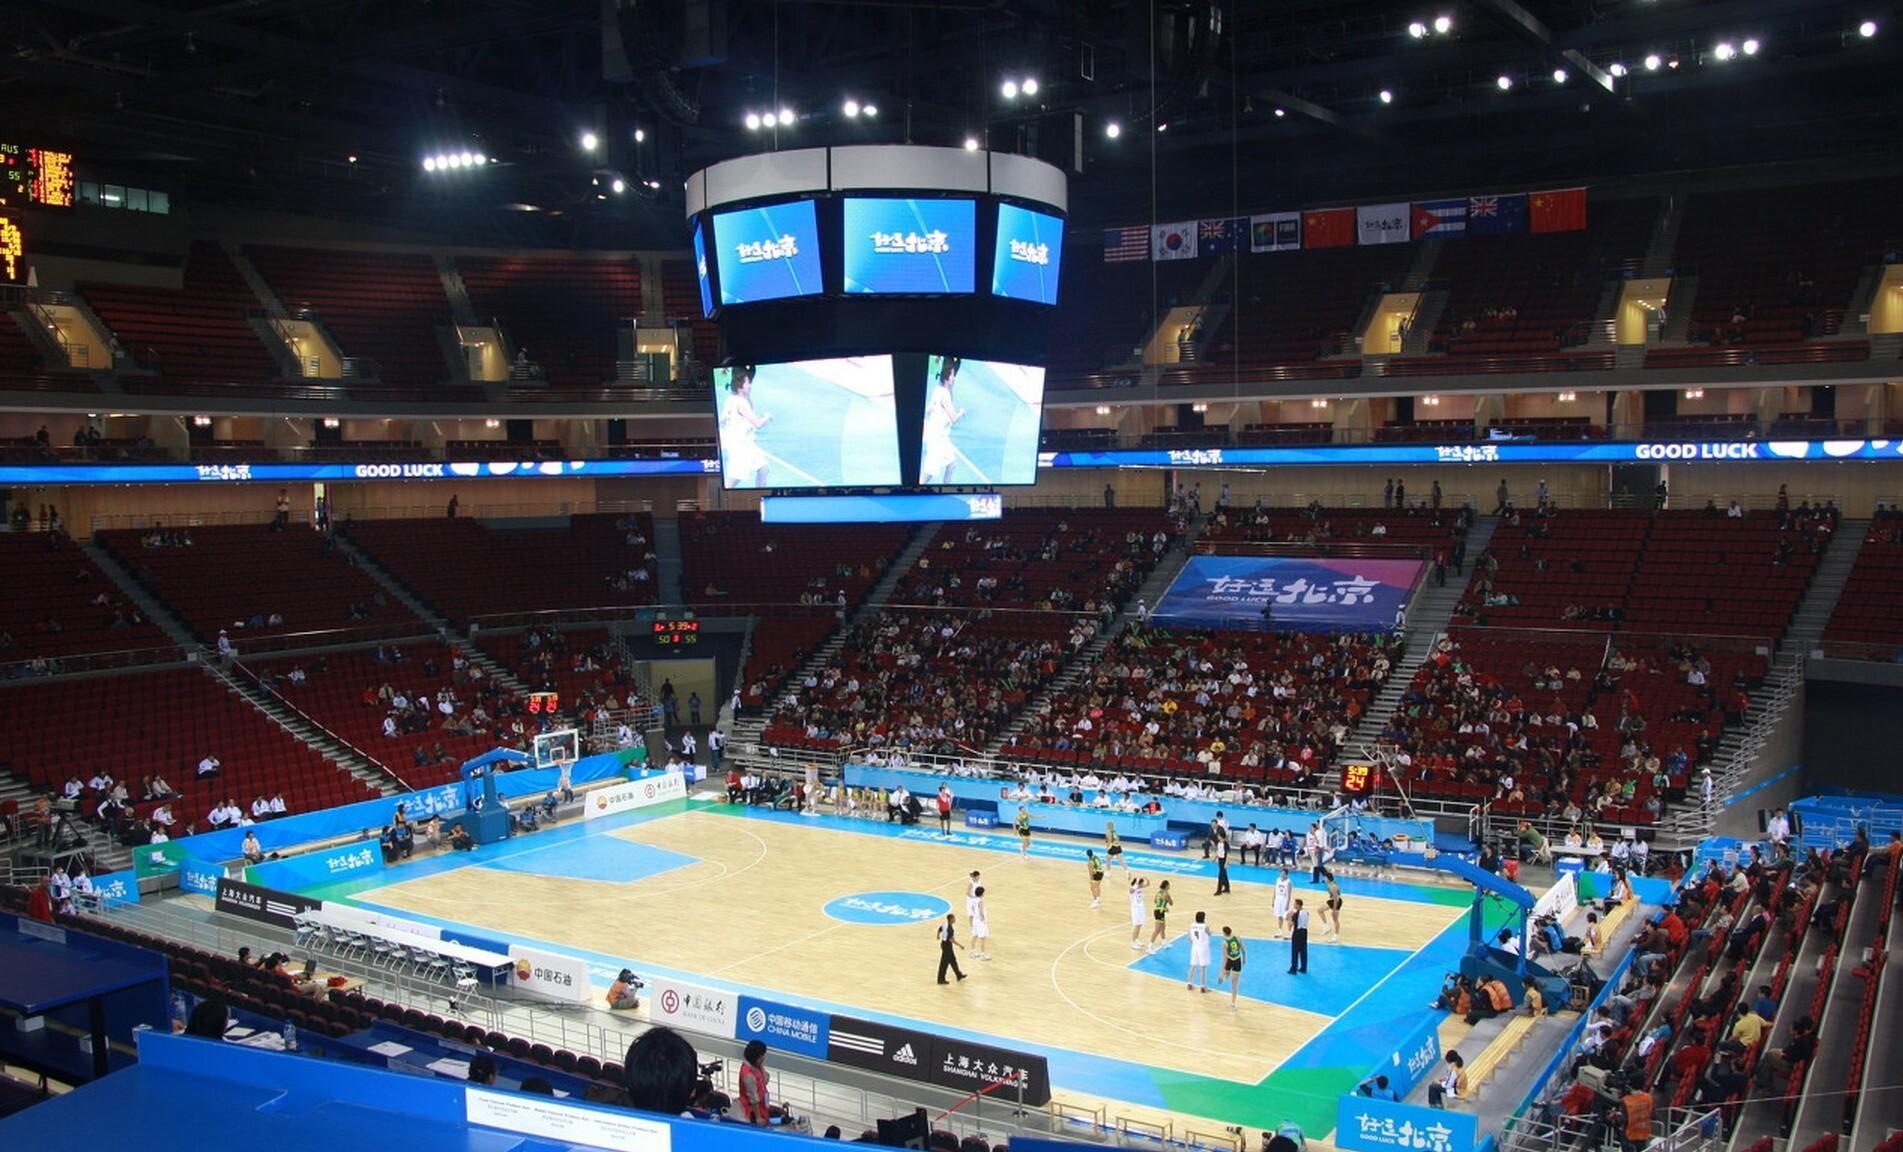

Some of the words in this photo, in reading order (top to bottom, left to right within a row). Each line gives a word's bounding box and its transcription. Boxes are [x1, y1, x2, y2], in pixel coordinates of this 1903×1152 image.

[1, 144, 19, 154] AUS
[1635, 444, 1698, 459] GOOD
[1701, 443, 1758, 459] LUCK
[355, 464, 402, 478] GOOD
[403, 463, 444, 477] LUCK
[1206, 575, 1381, 605] 好运北京
[1345, 775, 1365, 788] 24
[534, 967, 572, 987] 中国石油
[767, 1013, 818, 1035] 中国移动通信
[767, 1024, 790, 1037] CHINA
[791, 1029, 817, 1044] MOBILE
[892, 1054, 918, 1066] adidas
[944, 1052, 1029, 1081] 上海大众汽车
[943, 1065, 977, 1079] SHANGHAI
[980, 1073, 1029, 1090] VOLKWAGN
[1355, 1112, 1453, 1152] 好运北京
[1359, 1133, 1379, 1141] GOOD
